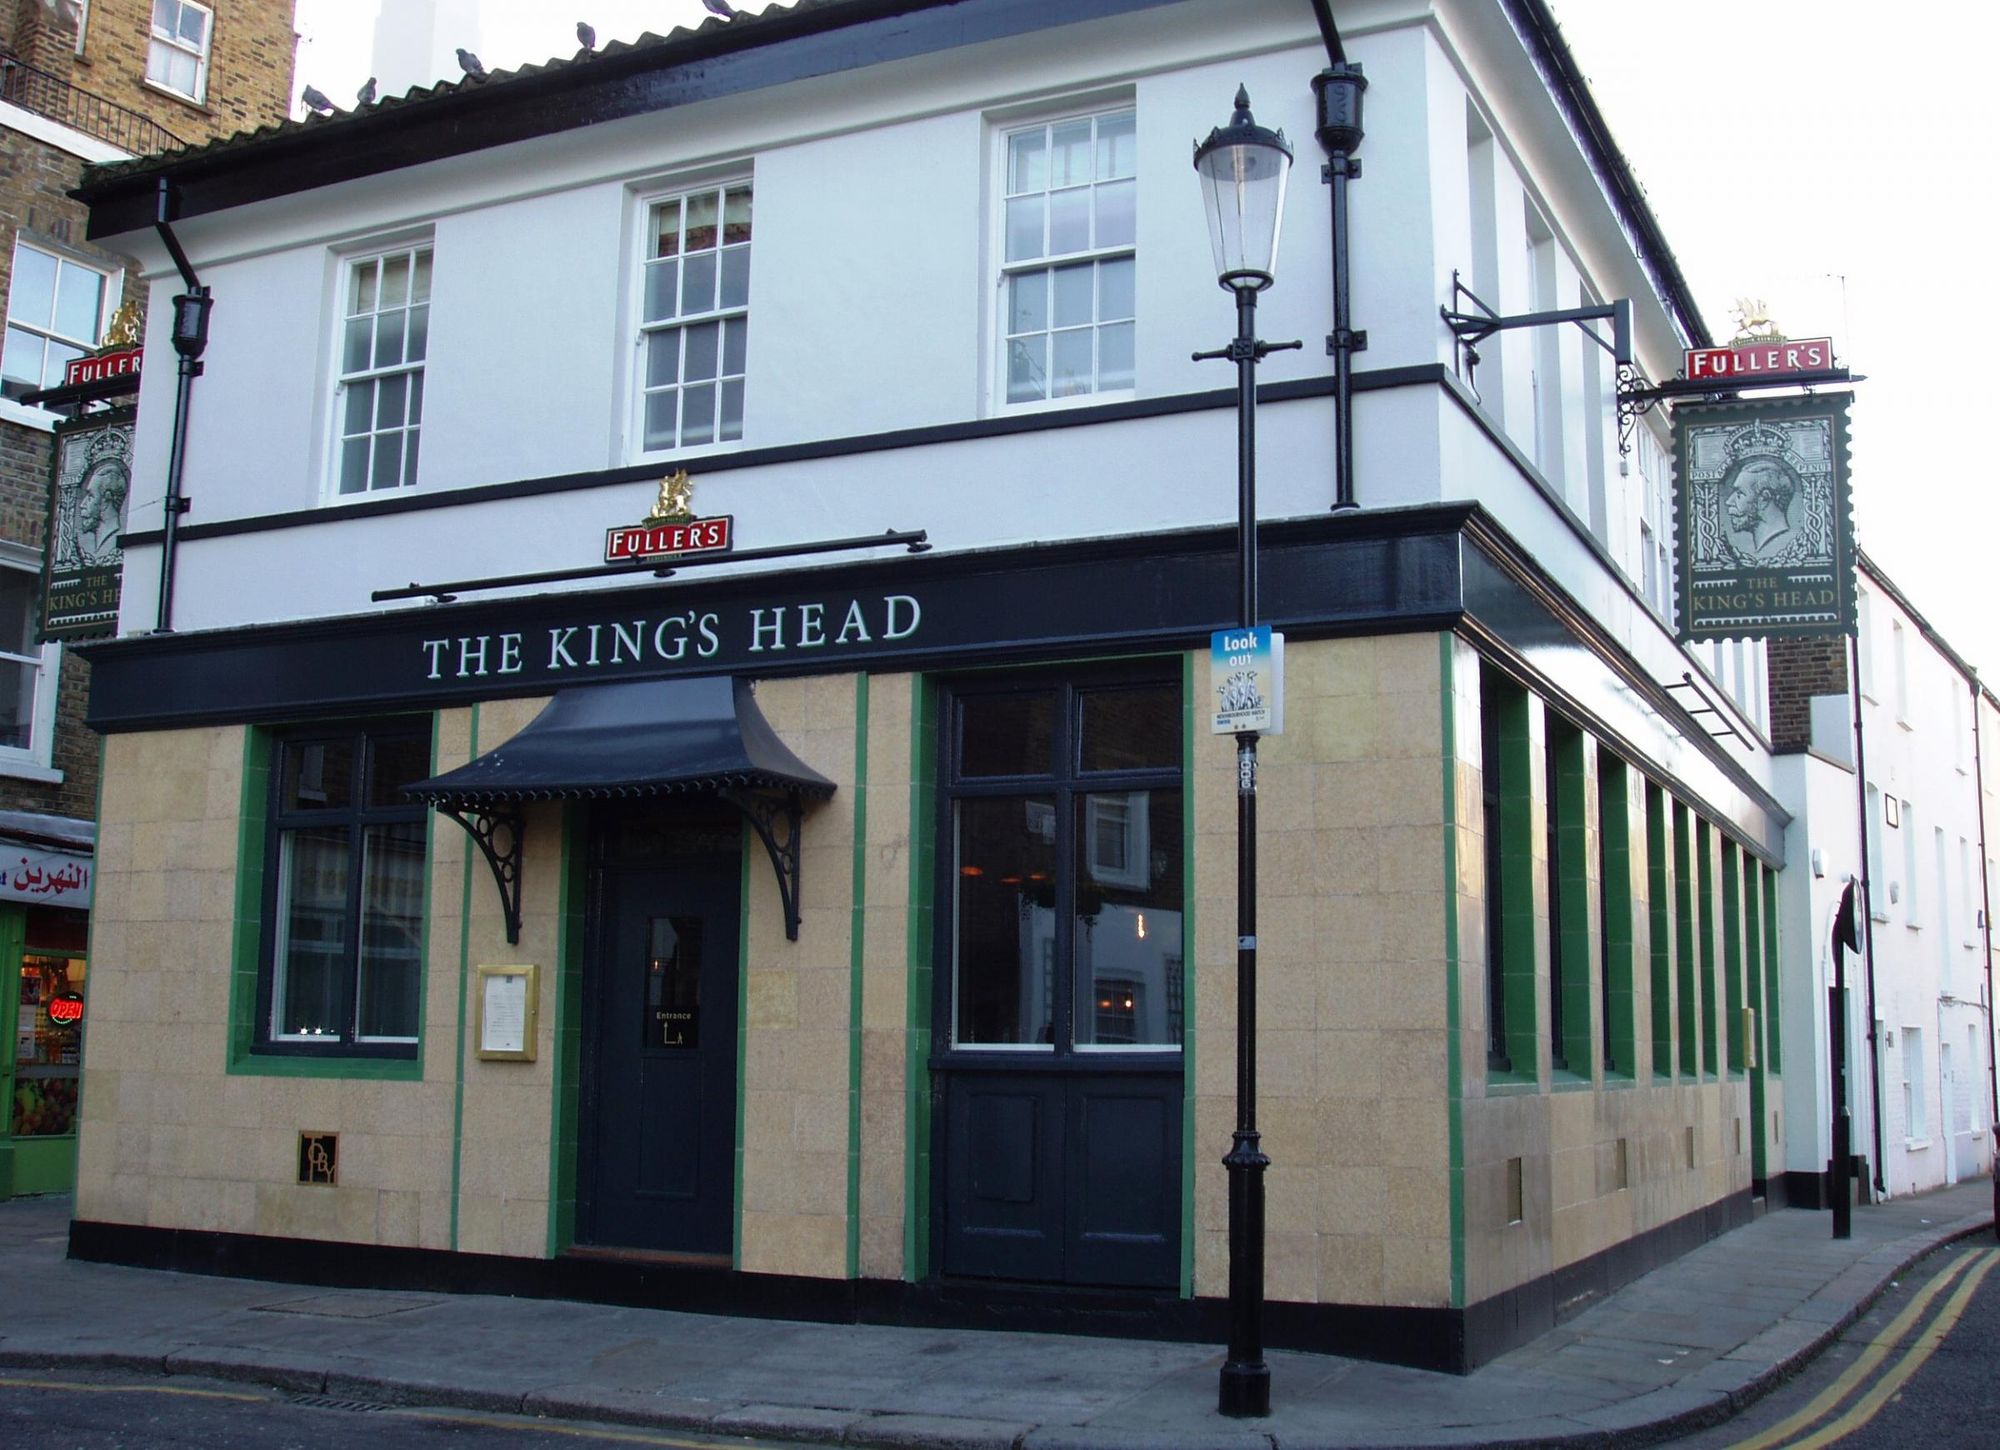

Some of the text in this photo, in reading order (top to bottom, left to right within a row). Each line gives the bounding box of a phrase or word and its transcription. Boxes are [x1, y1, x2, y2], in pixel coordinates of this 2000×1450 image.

[1693, 345, 1823, 375] FULLER'S
[612, 523, 719, 554] FULLER'S
[86, 575, 108, 588] THE
[1747, 576, 1778, 590] THE
[48, 590, 98, 612] KING'S
[1693, 590, 1835, 612] KING'S HEAD
[422, 594, 923, 680] THE KING'S HEAD
[1224, 632, 1258, 651] Look
[14, 856, 88, 895] النهرين
[50, 998, 83, 1019] OPEN
[656, 1011, 692, 1020] Entrance
